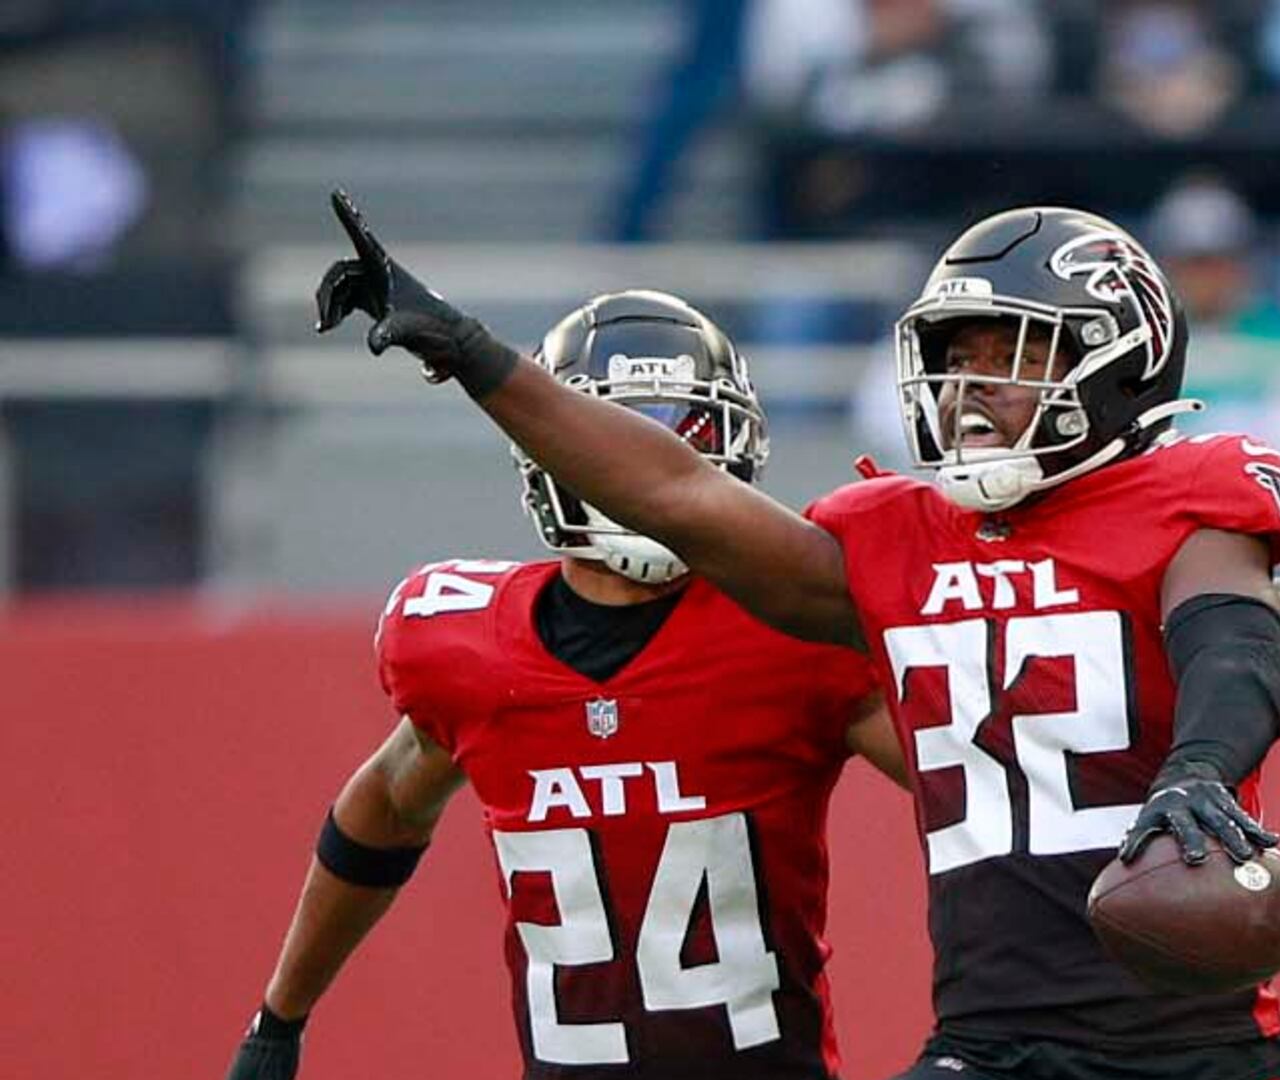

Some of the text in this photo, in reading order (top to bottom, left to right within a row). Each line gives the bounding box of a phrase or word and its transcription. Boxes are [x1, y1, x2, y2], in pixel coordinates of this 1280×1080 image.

[630, 362, 672, 375] ATL
[402, 558, 524, 617] 4
[921, 558, 1079, 615] ATL
[883, 610, 1145, 875] 32
[526, 761, 707, 822] ATL
[492, 811, 782, 1066] 24
